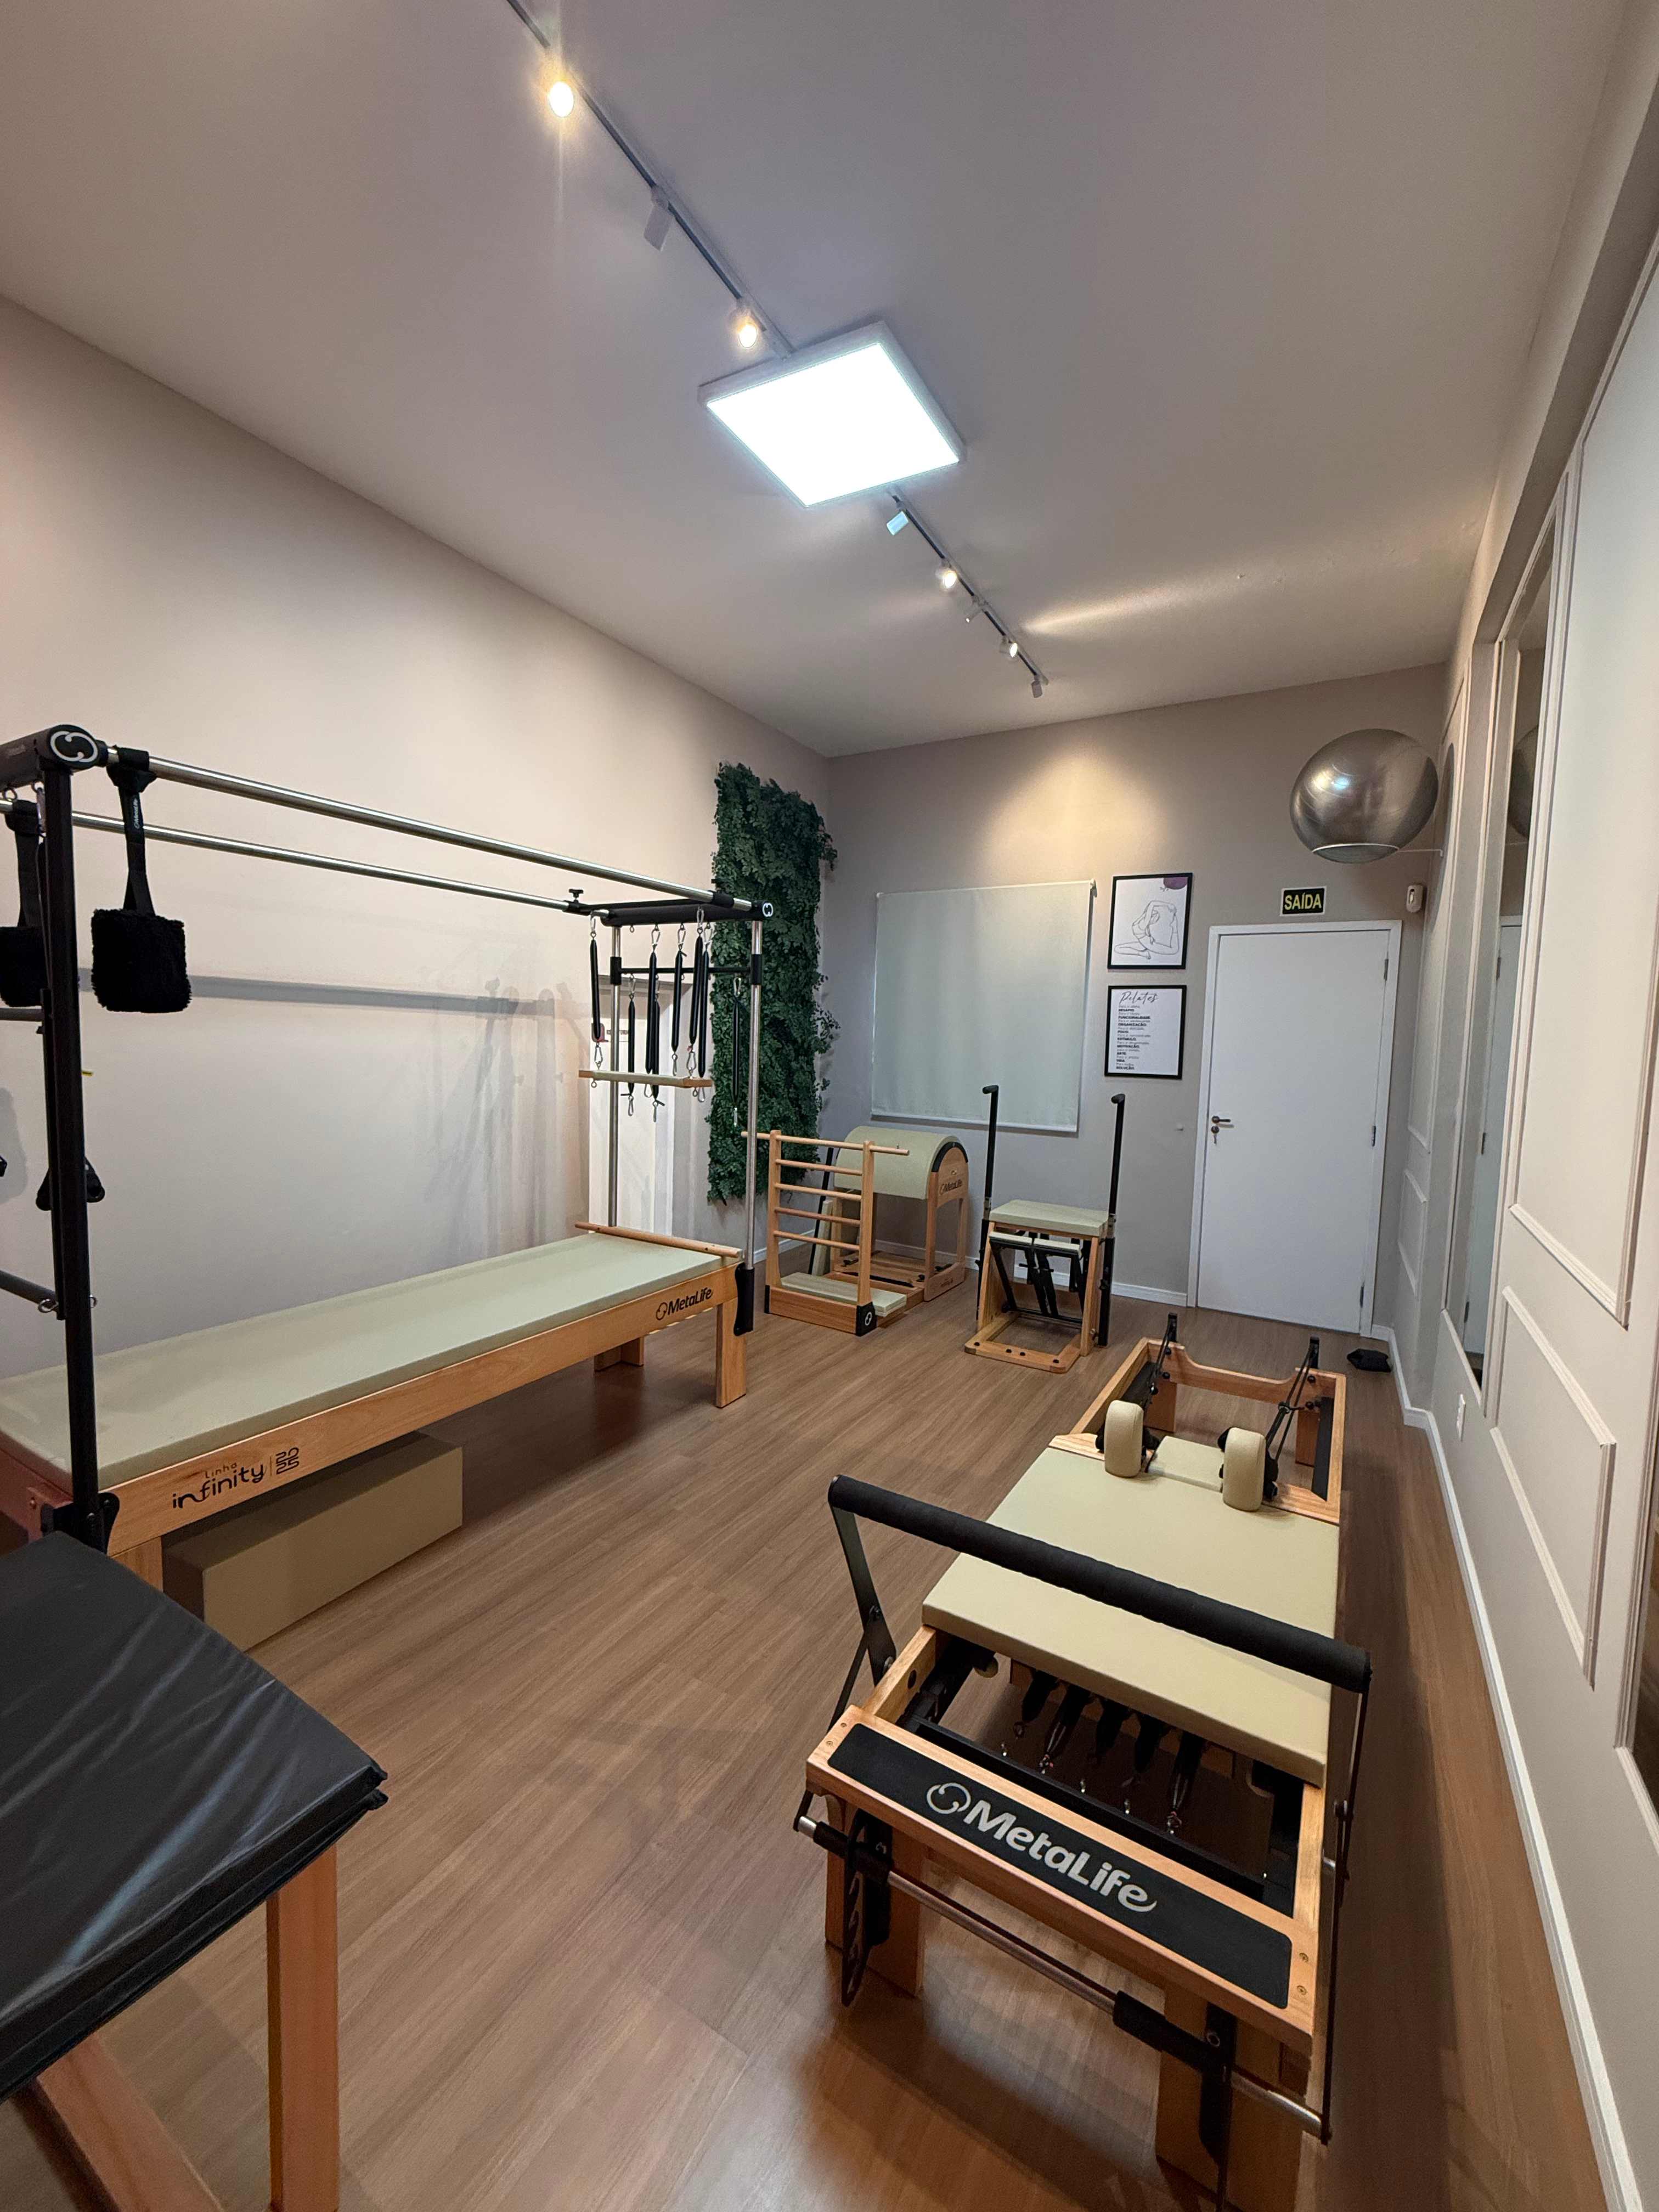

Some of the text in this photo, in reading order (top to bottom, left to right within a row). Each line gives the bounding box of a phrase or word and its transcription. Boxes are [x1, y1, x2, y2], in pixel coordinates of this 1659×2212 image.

[1284, 892, 1322, 910] SAÍDA
[1119, 991, 1158, 1004] Pilates
[668, 1287, 713, 1316] MetaLife
[172, 1464, 267, 1509] infinity
[963, 1799, 1157, 1912] MetaLife
